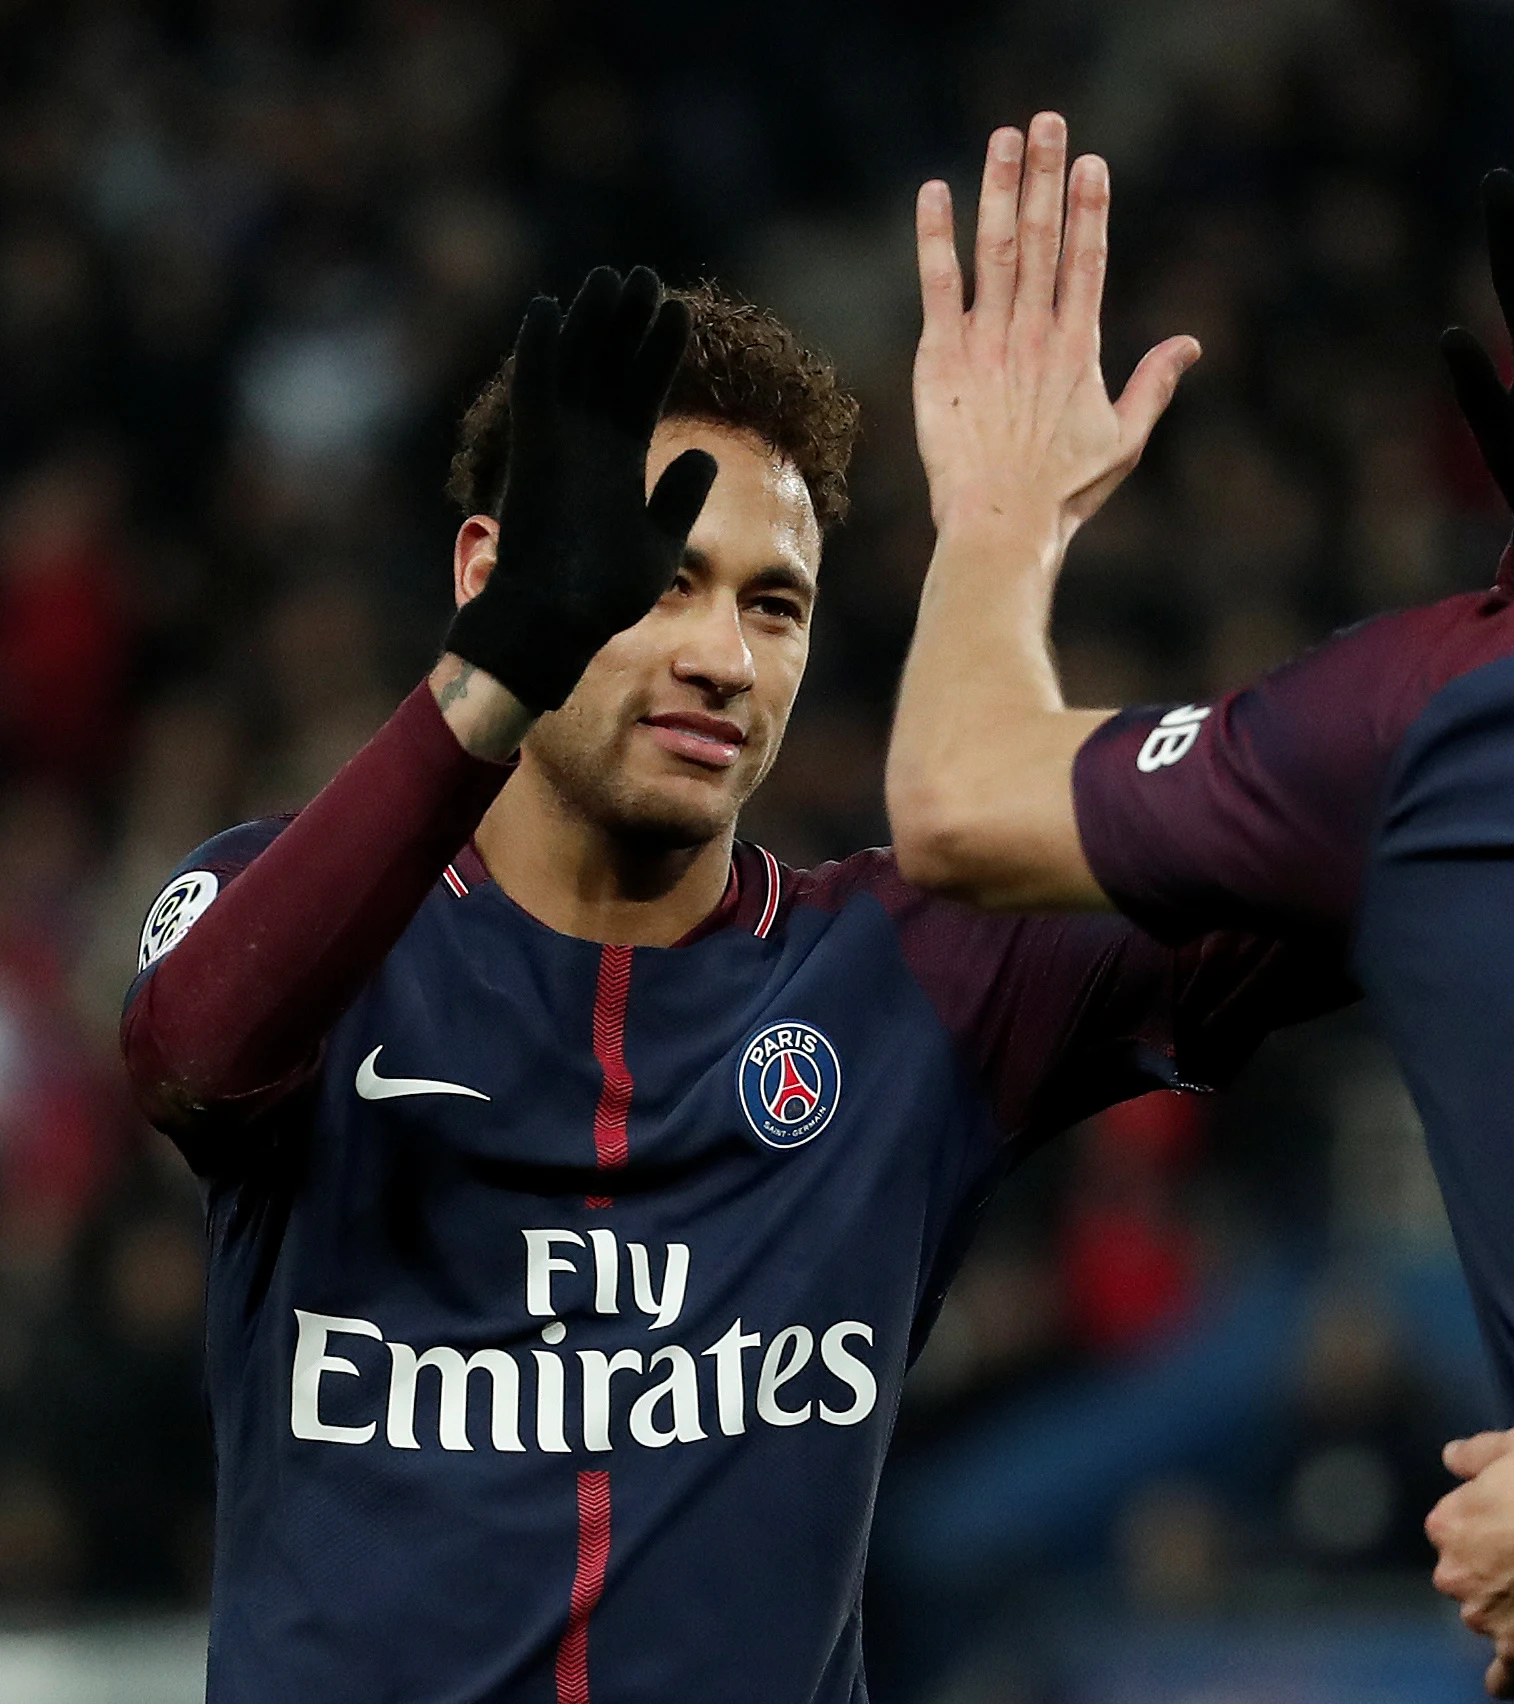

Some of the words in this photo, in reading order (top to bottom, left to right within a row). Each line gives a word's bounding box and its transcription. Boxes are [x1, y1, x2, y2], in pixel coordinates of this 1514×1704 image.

[749, 1030, 818, 1067] PARIS
[520, 1229, 690, 1331] Fly
[291, 1308, 877, 1453] Emirates
